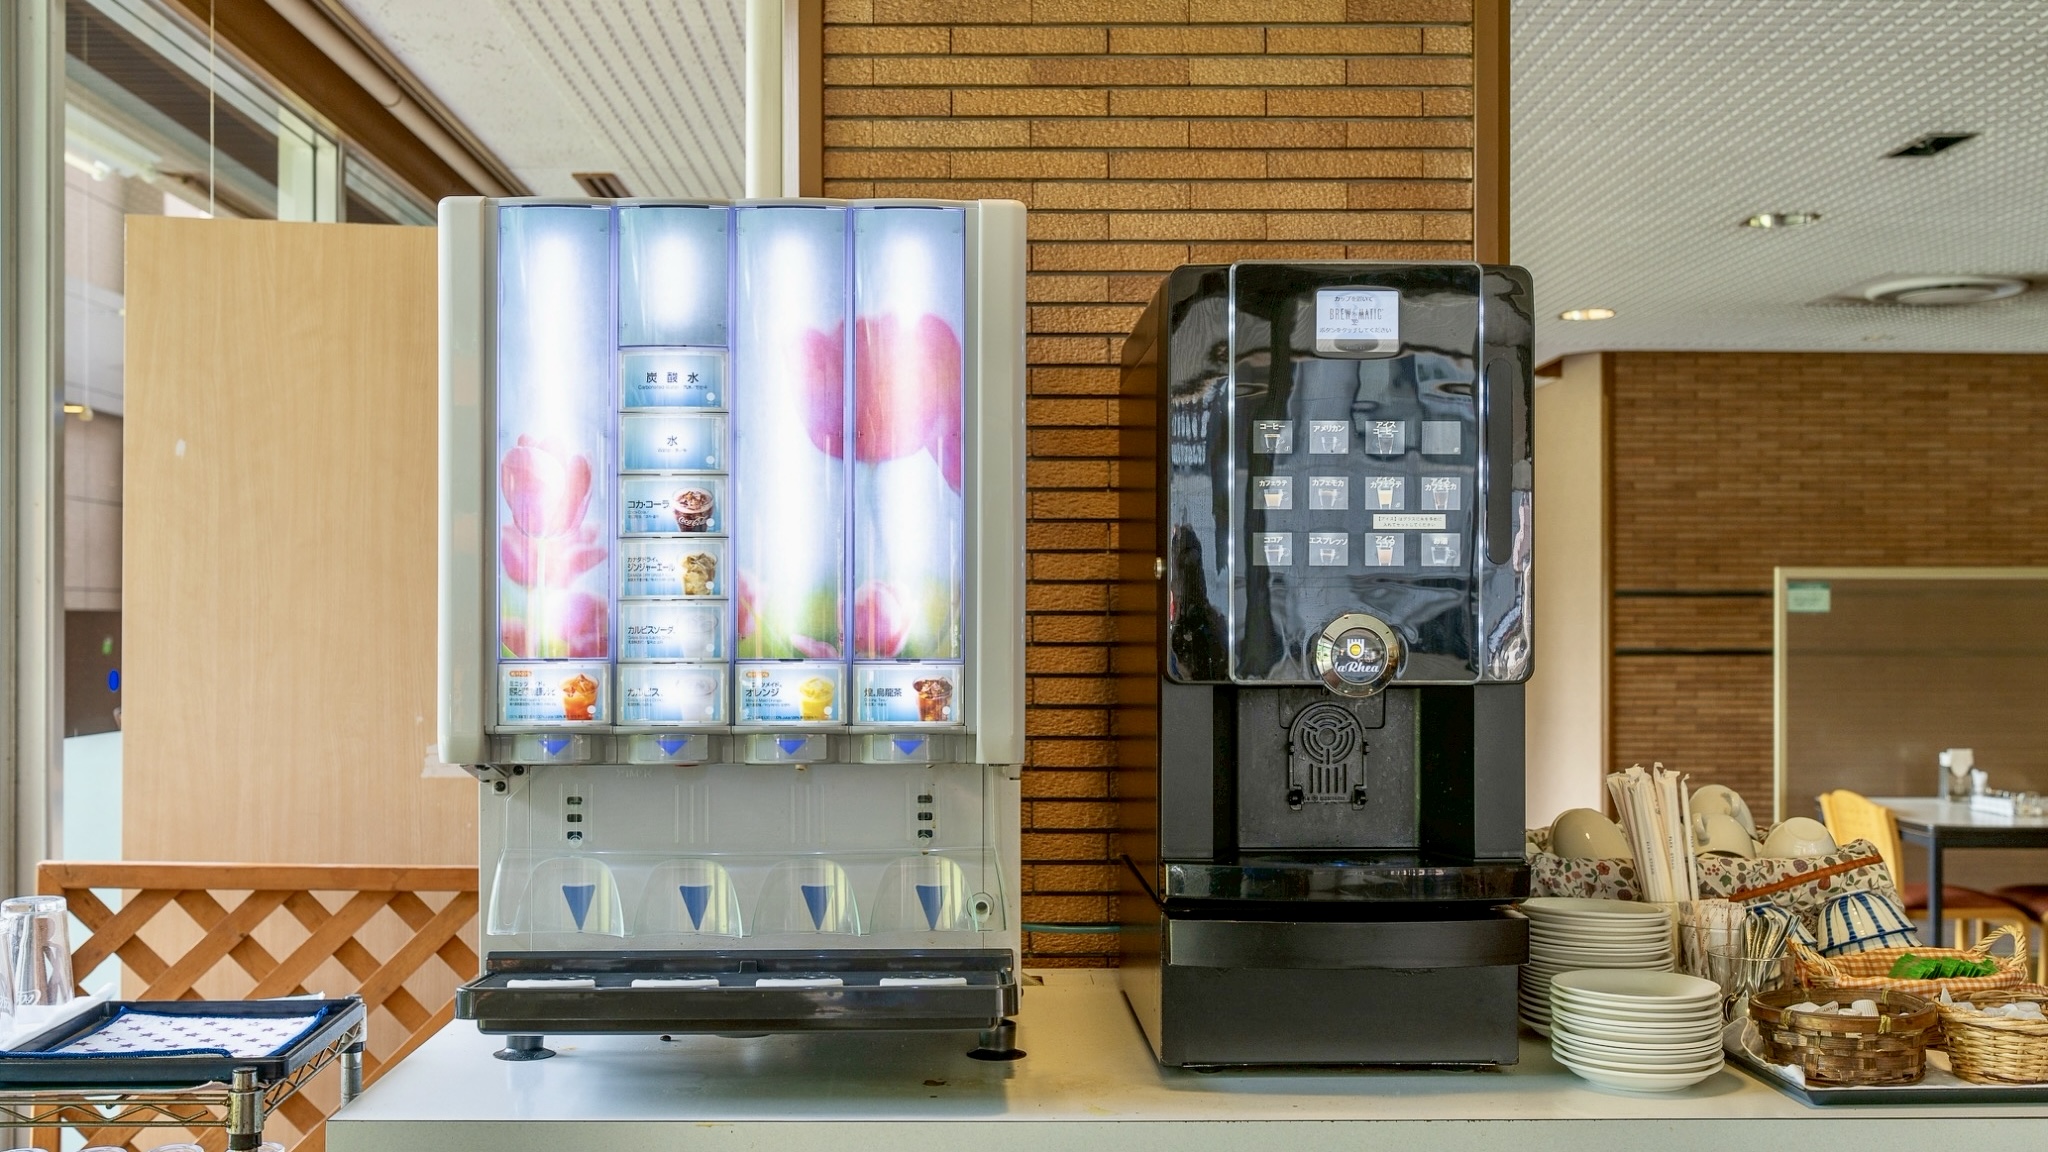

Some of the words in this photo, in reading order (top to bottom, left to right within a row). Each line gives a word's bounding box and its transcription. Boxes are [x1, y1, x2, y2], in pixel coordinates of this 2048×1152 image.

[646, 372, 699, 383] 炭酸水
[1313, 425, 1345, 433] アメリカン
[666, 435, 678, 446] 水
[1312, 479, 1345, 487] カフェモカ
[627, 500, 670, 509] コカ・コーラ
[1264, 536, 1283, 544] ココア
[1309, 536, 1348, 546] エスプレッソ
[745, 688, 779, 697] オレンジ
